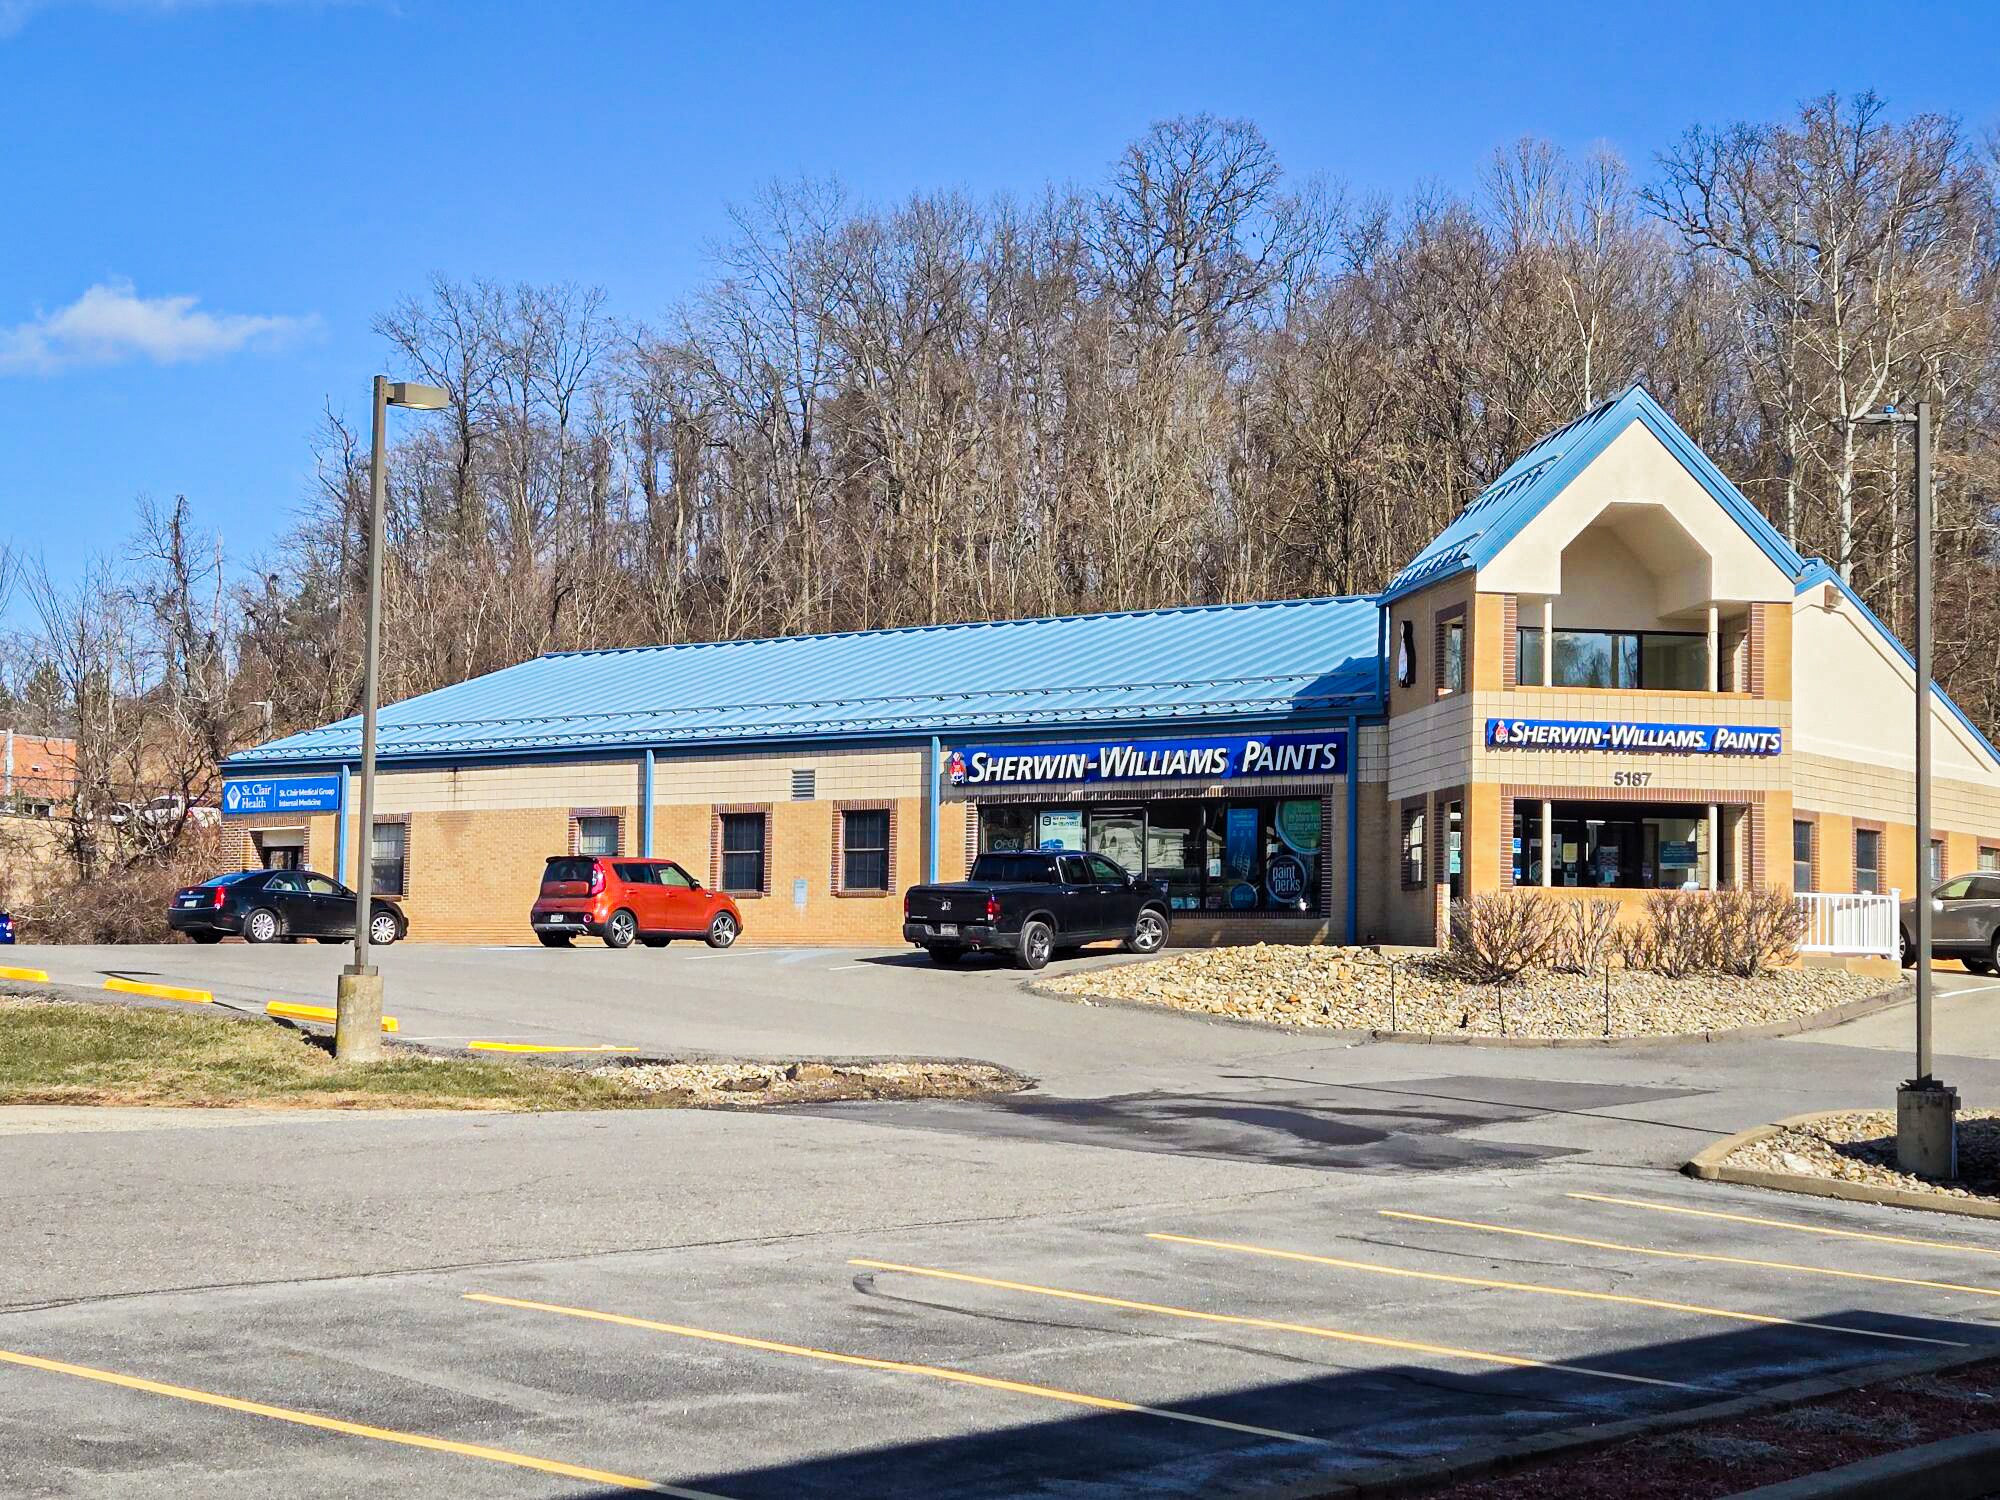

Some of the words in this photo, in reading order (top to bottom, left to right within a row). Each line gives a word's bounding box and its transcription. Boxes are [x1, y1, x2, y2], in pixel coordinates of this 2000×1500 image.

[1714, 728, 1780, 750] PAINTS
[968, 746, 1228, 783] SHERWIN-WILLIAMS
[1242, 740, 1337, 773] PAINTS
[1613, 771, 1652, 787] 5187
[252, 783, 272, 796] Clair
[299, 788, 319, 796] Medical
[319, 787, 335, 796] Group
[241, 797, 267, 809] Health
[994, 839, 1019, 850] OPEN
[1272, 864, 1296, 881] paint
[1275, 877, 1301, 893] perks
